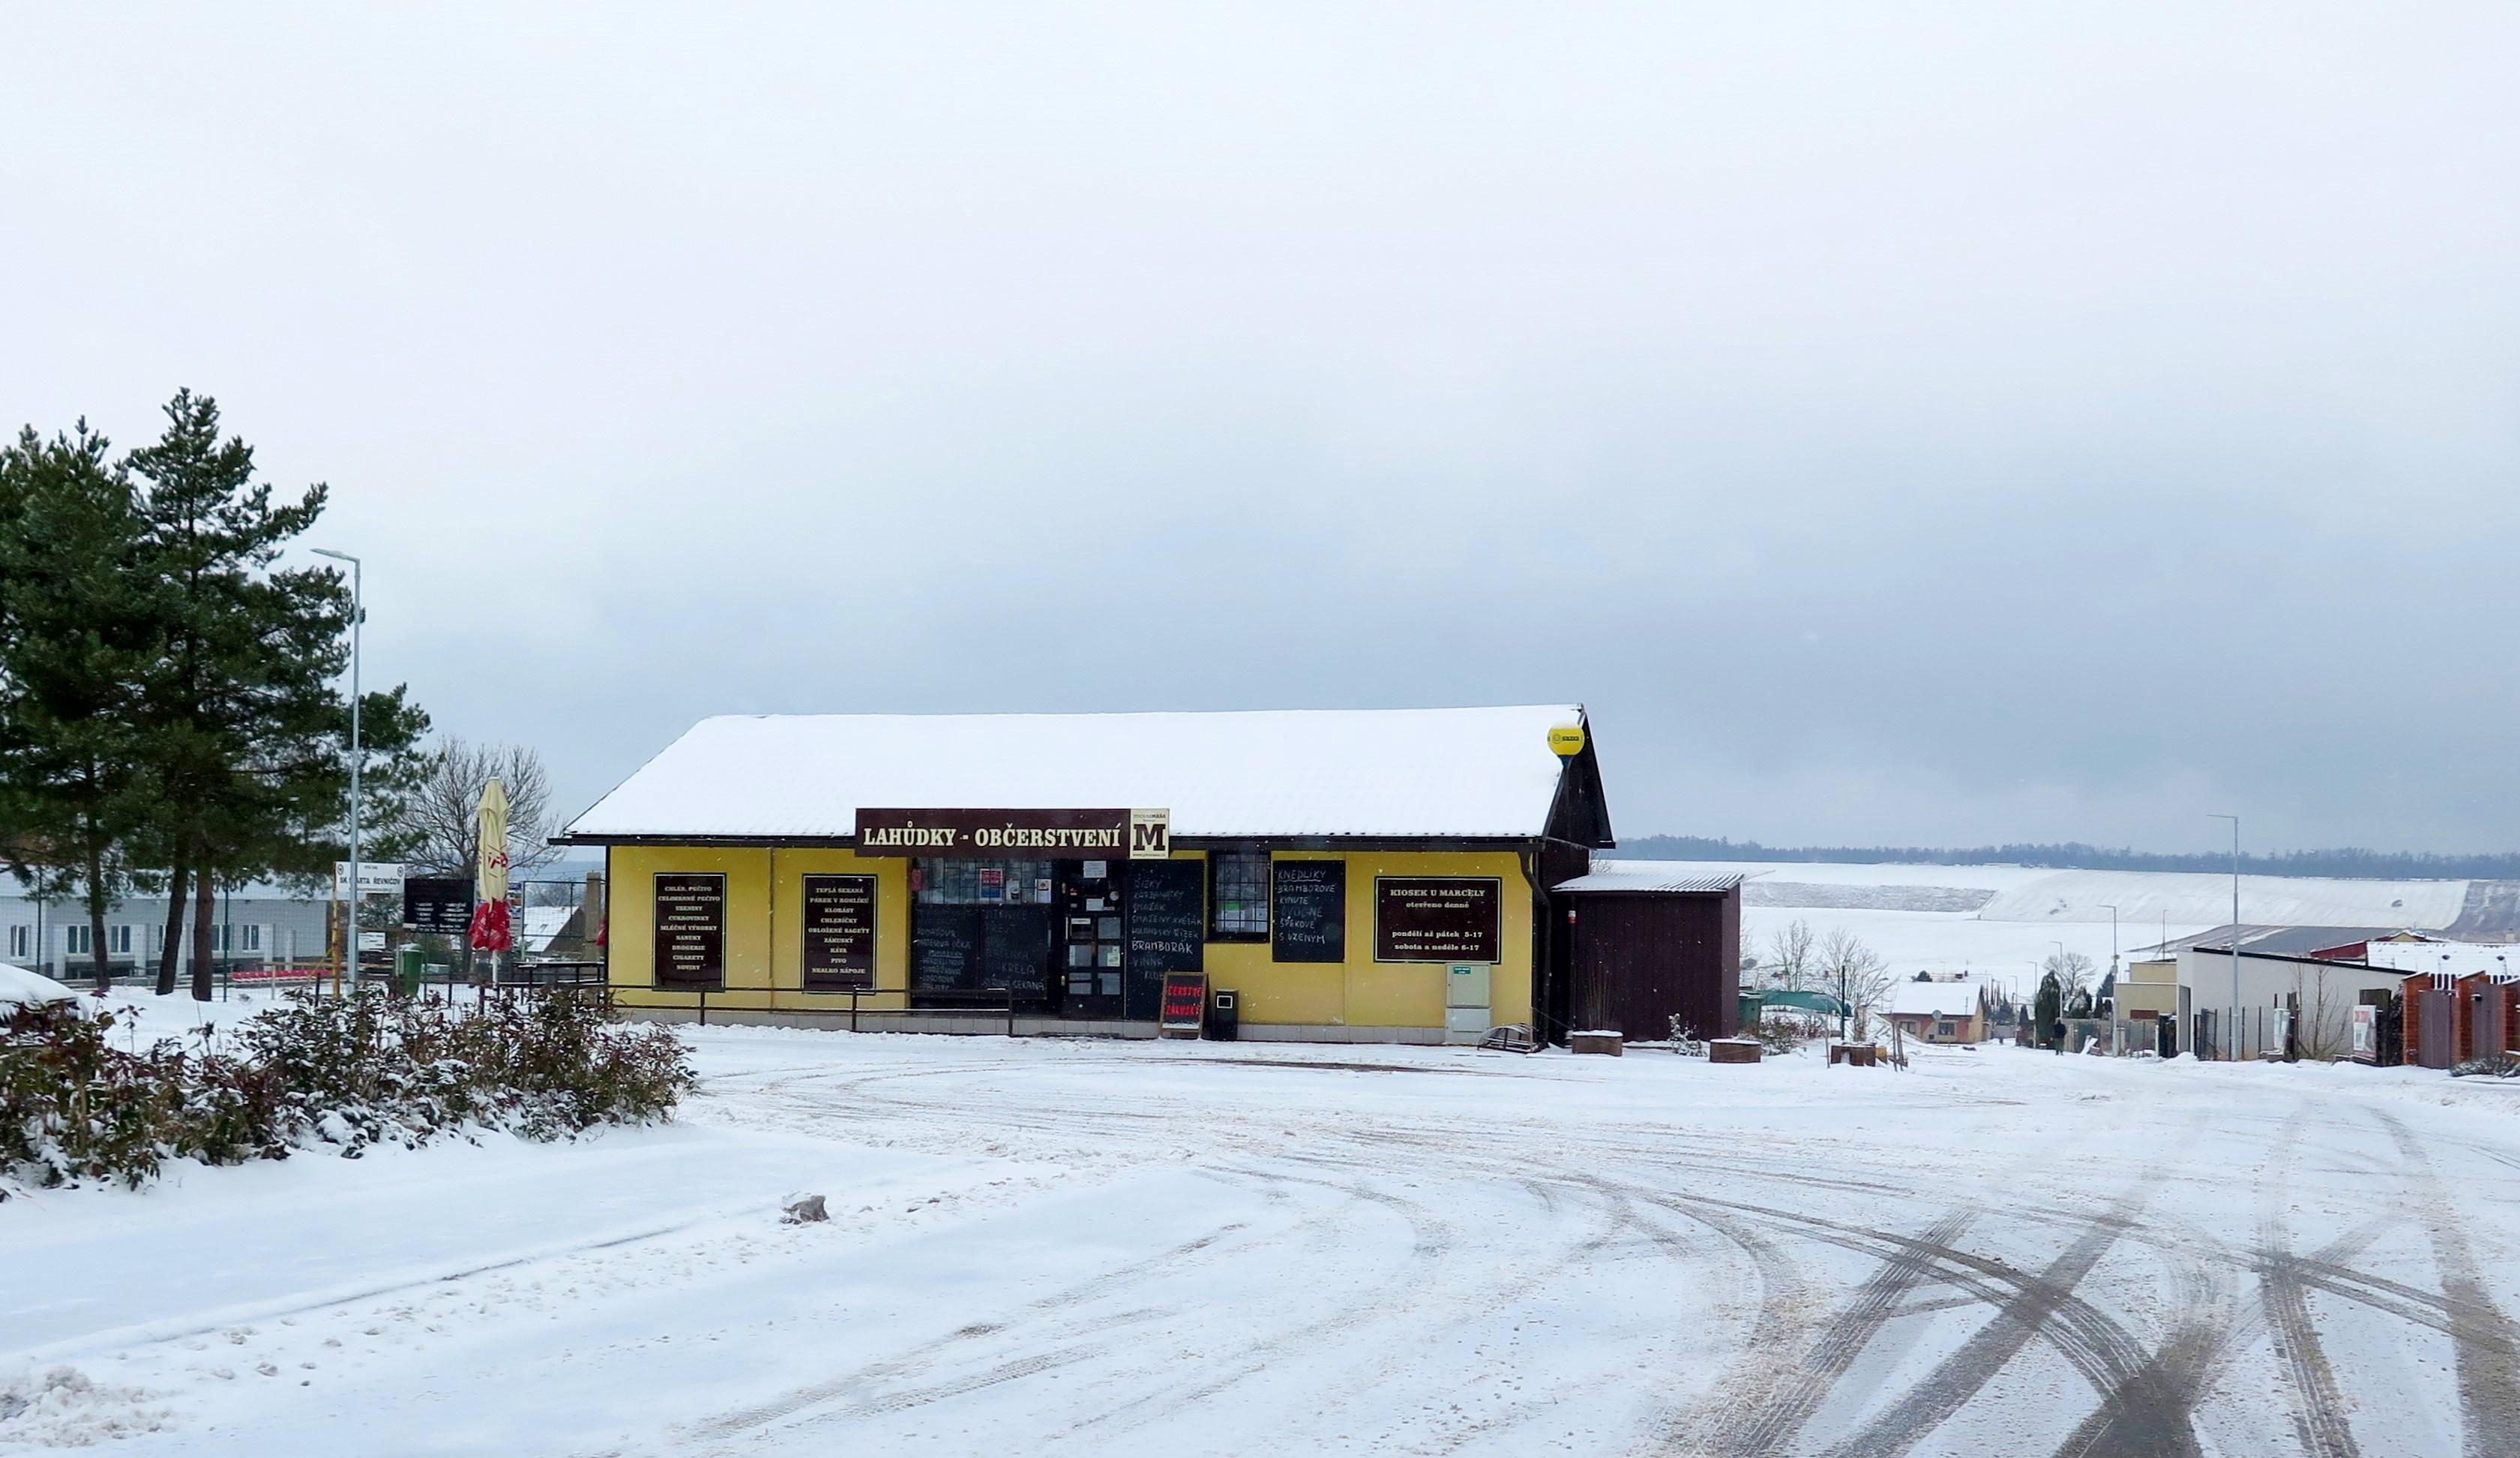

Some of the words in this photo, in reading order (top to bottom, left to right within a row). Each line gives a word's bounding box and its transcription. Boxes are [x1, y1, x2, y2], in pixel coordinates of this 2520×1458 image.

[863, 820, 957, 846] LAHŮDKY
[975, 823, 1121, 847] OBČERSTVENÍ
[1133, 824, 1166, 850] M
[1279, 932, 1284, 940] S
[1392, 930, 1422, 938] pondělí
[1436, 931, 1460, 939] pátek
